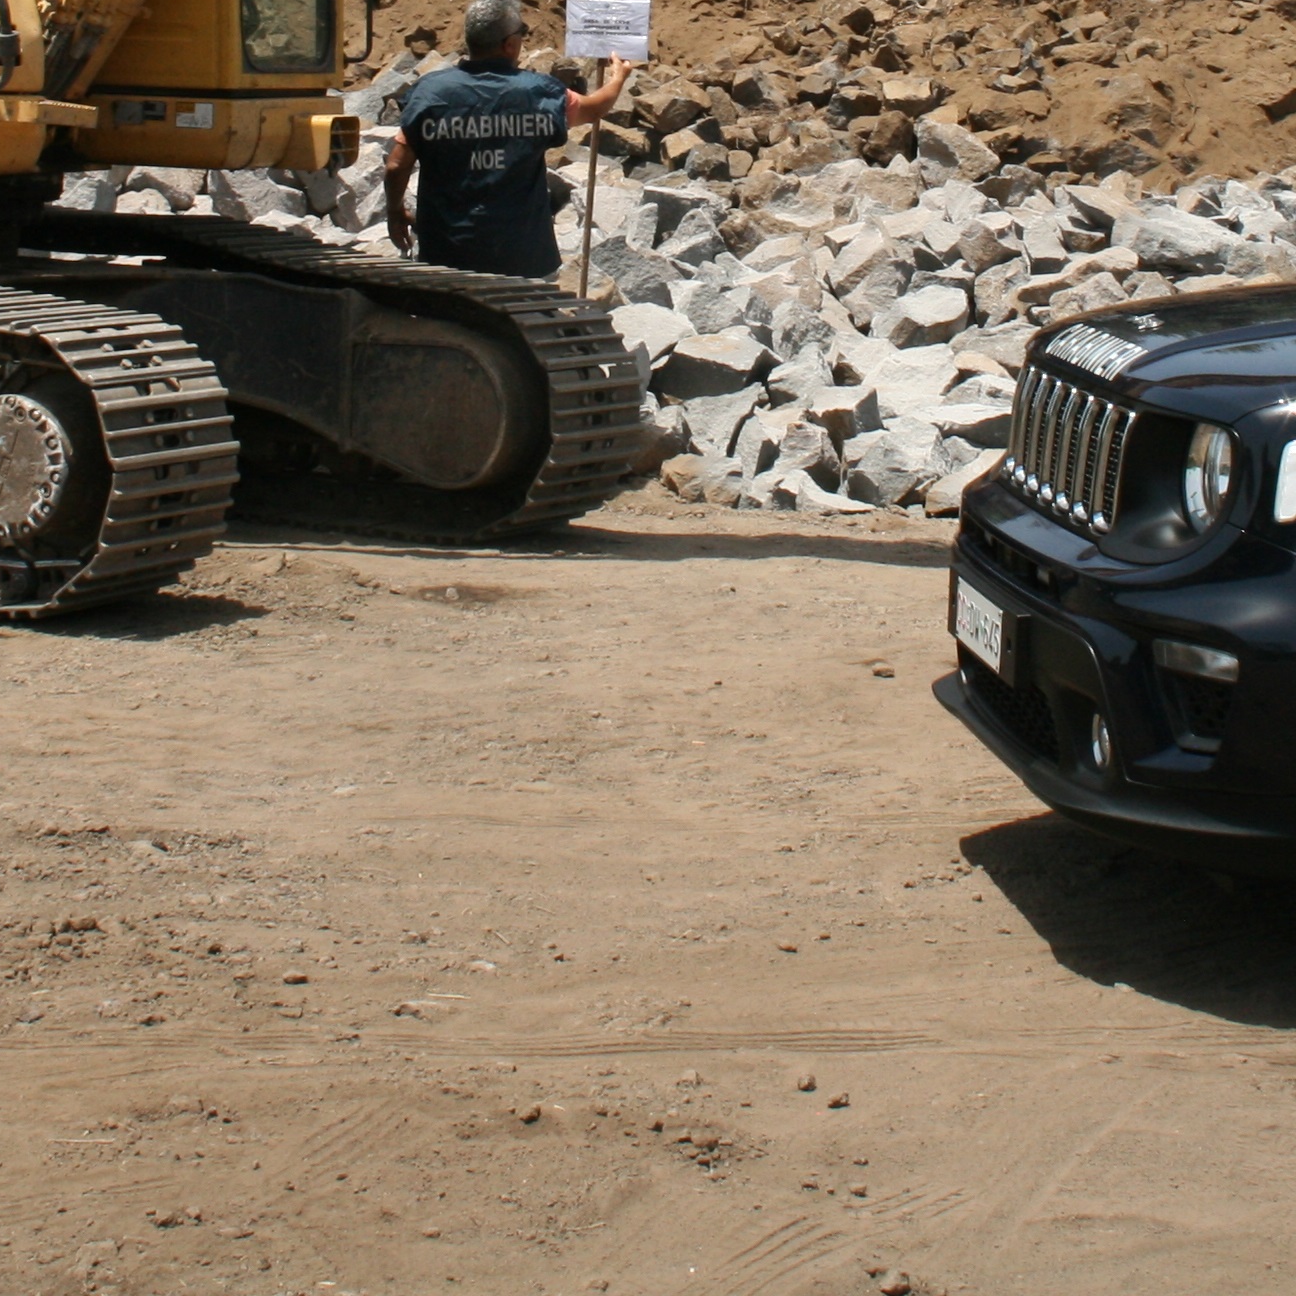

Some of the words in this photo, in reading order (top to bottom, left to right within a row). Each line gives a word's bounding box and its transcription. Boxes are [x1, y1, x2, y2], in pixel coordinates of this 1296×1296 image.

[422, 113, 554, 141] CARABINIERI
[470, 149, 506, 171] NOE
[1044, 323, 1149, 382] CARABINIERI
